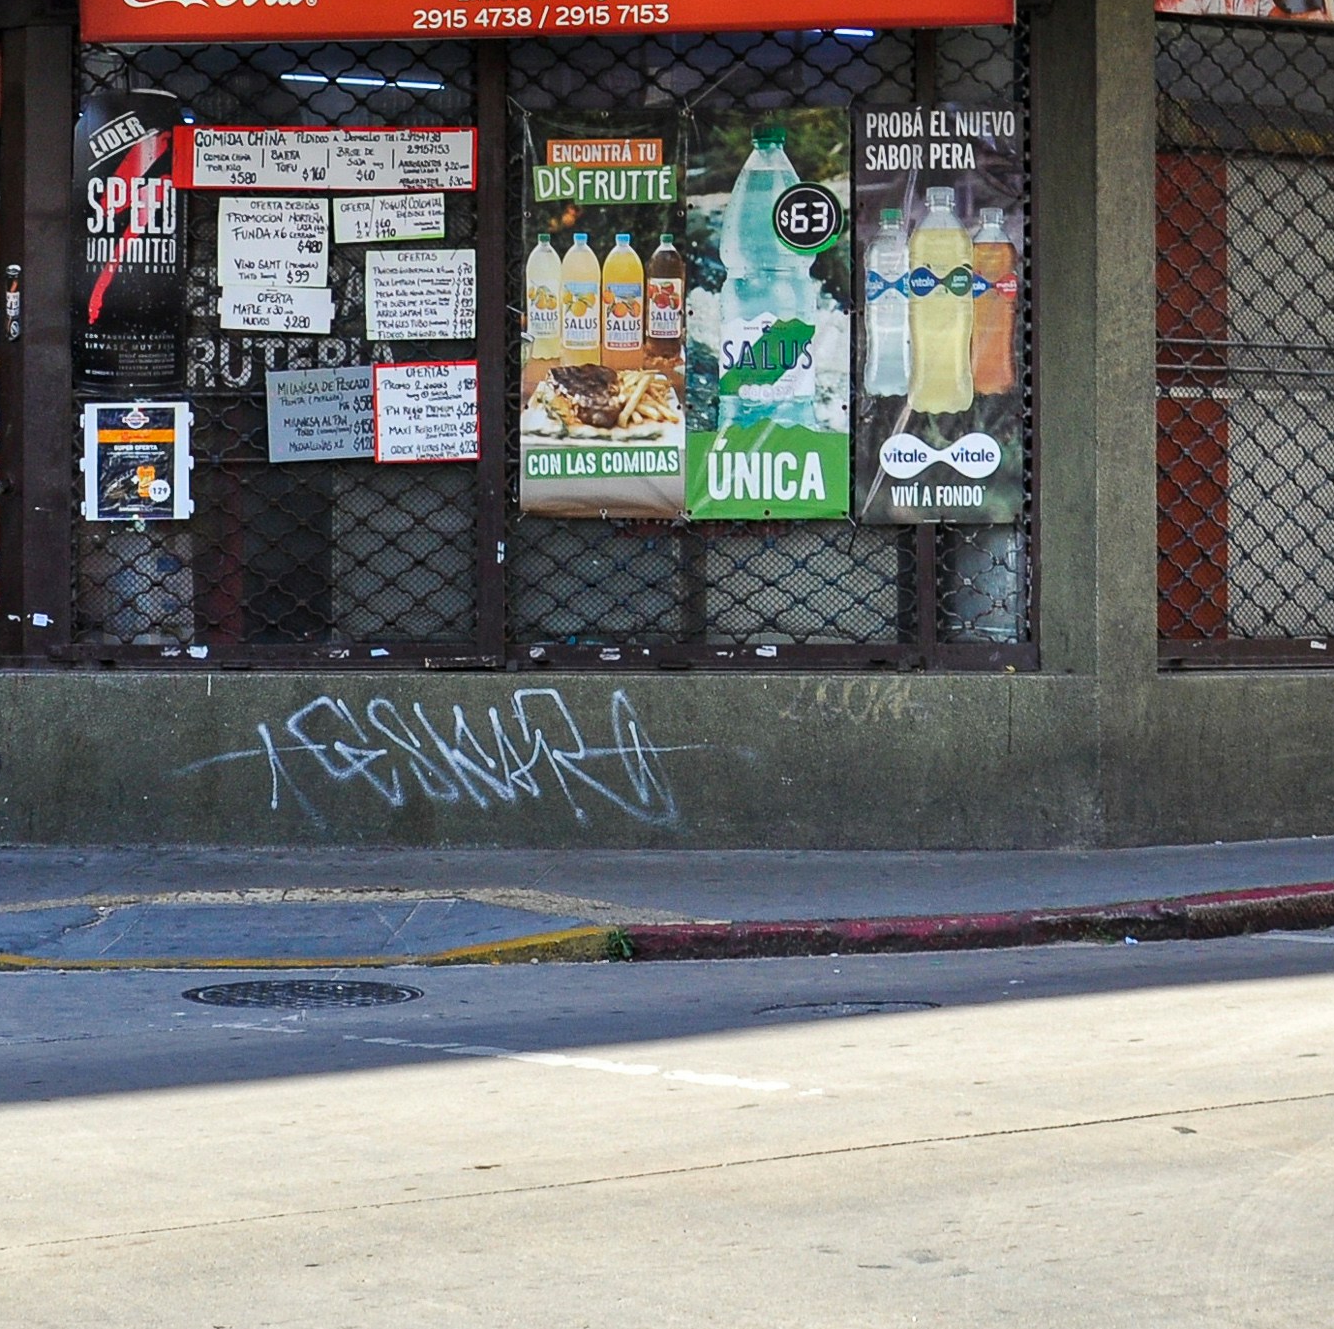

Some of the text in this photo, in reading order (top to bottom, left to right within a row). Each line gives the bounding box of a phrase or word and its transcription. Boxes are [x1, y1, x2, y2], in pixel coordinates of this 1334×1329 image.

[413, 9, 467, 29] 2915
[473, 7, 531, 28] 4738
[555, 5, 610, 26] 2915
[617, 4, 669, 24] 7153
[866, 106, 1015, 138] PROBÁ EL NUEVO
[195, 131, 243, 147] COMIDA
[248, 132, 287, 146] CHINA
[553, 139, 656, 162] ENCONTRÁ TU
[866, 143, 976, 170] SABOR PERA
[230, 172, 257, 185] $580
[538, 166, 672, 200] DISFRUTTÉ
[87, 176, 176, 234] SPEED
[250, 200, 283, 211] OFERTA
[340, 202, 372, 212] OFERTA
[780, 202, 829, 233] $63
[232, 226, 271, 241] FUNDA
[86, 237, 176, 264] UNLIMITED
[398, 252, 438, 262] OFERTAS
[287, 270, 310, 285] $99
[257, 293, 294, 304] OFERTA
[284, 315, 311, 329] $280
[530, 312, 559, 321] SALUS
[565, 318, 598, 330] SALUS
[651, 312, 680, 321] SALUS
[606, 319, 641, 331] SALUS
[186, 337, 395, 387] RUTERIA
[723, 339, 813, 370] SALUS
[406, 366, 450, 378] OFERTAS
[322, 381, 334, 392] DE
[336, 376, 370, 391] PESCADO
[527, 450, 679, 475] CON LAS COMIDAS
[883, 448, 928, 463] vitale
[950, 447, 995, 463] vitale
[707, 438, 826, 502] ÚNICA
[153, 487, 168, 495] 129
[891, 481, 983, 506] VIVÍ A FONDO
